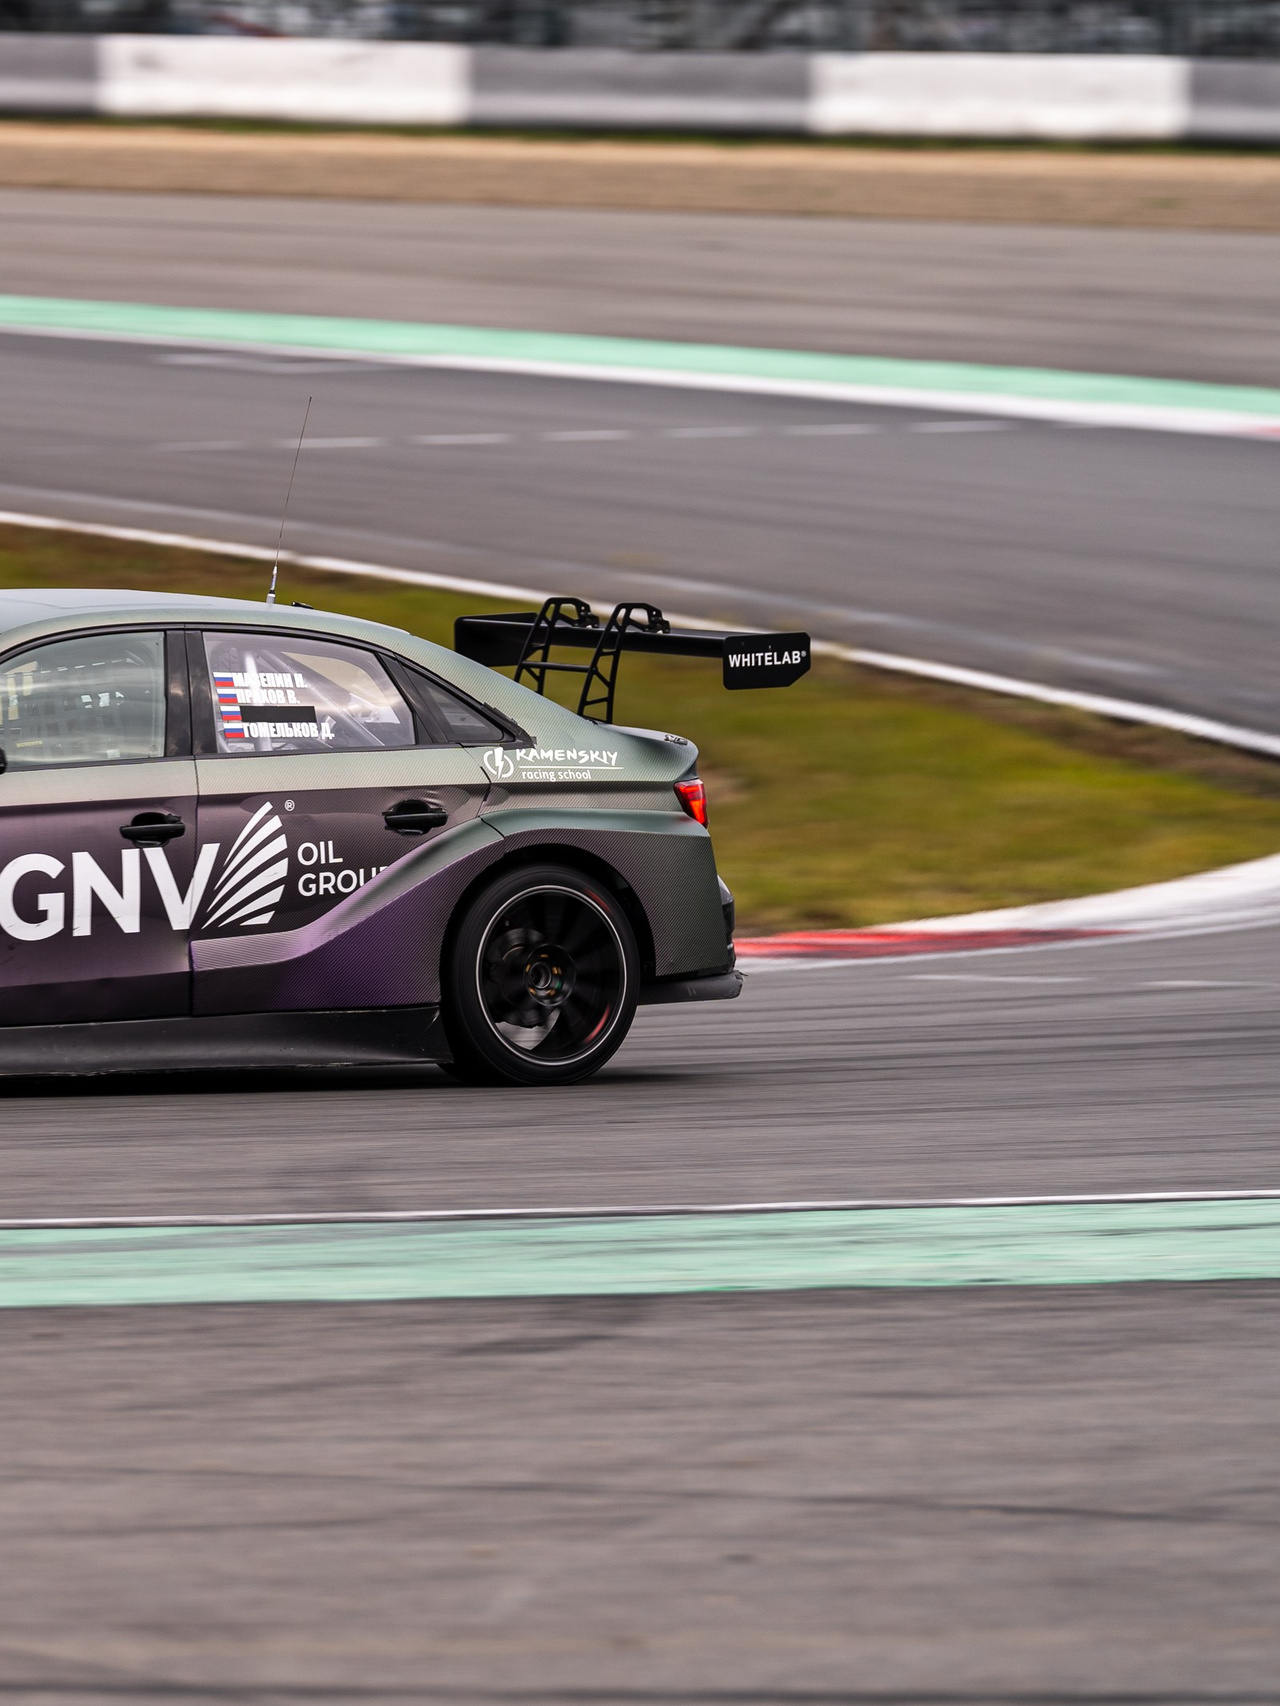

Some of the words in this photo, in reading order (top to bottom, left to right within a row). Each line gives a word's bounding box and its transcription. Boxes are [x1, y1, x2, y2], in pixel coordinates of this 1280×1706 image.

[243, 722, 319, 738] ТОМЕЛЬКОВ
[321, 722, 336, 740] Д.
[516, 749, 618, 766] KAMENSKIY
[522, 769, 556, 782] racing
[558, 770, 592, 780] school
[297, 840, 344, 866] OIL
[298, 866, 388, 897] GROU
